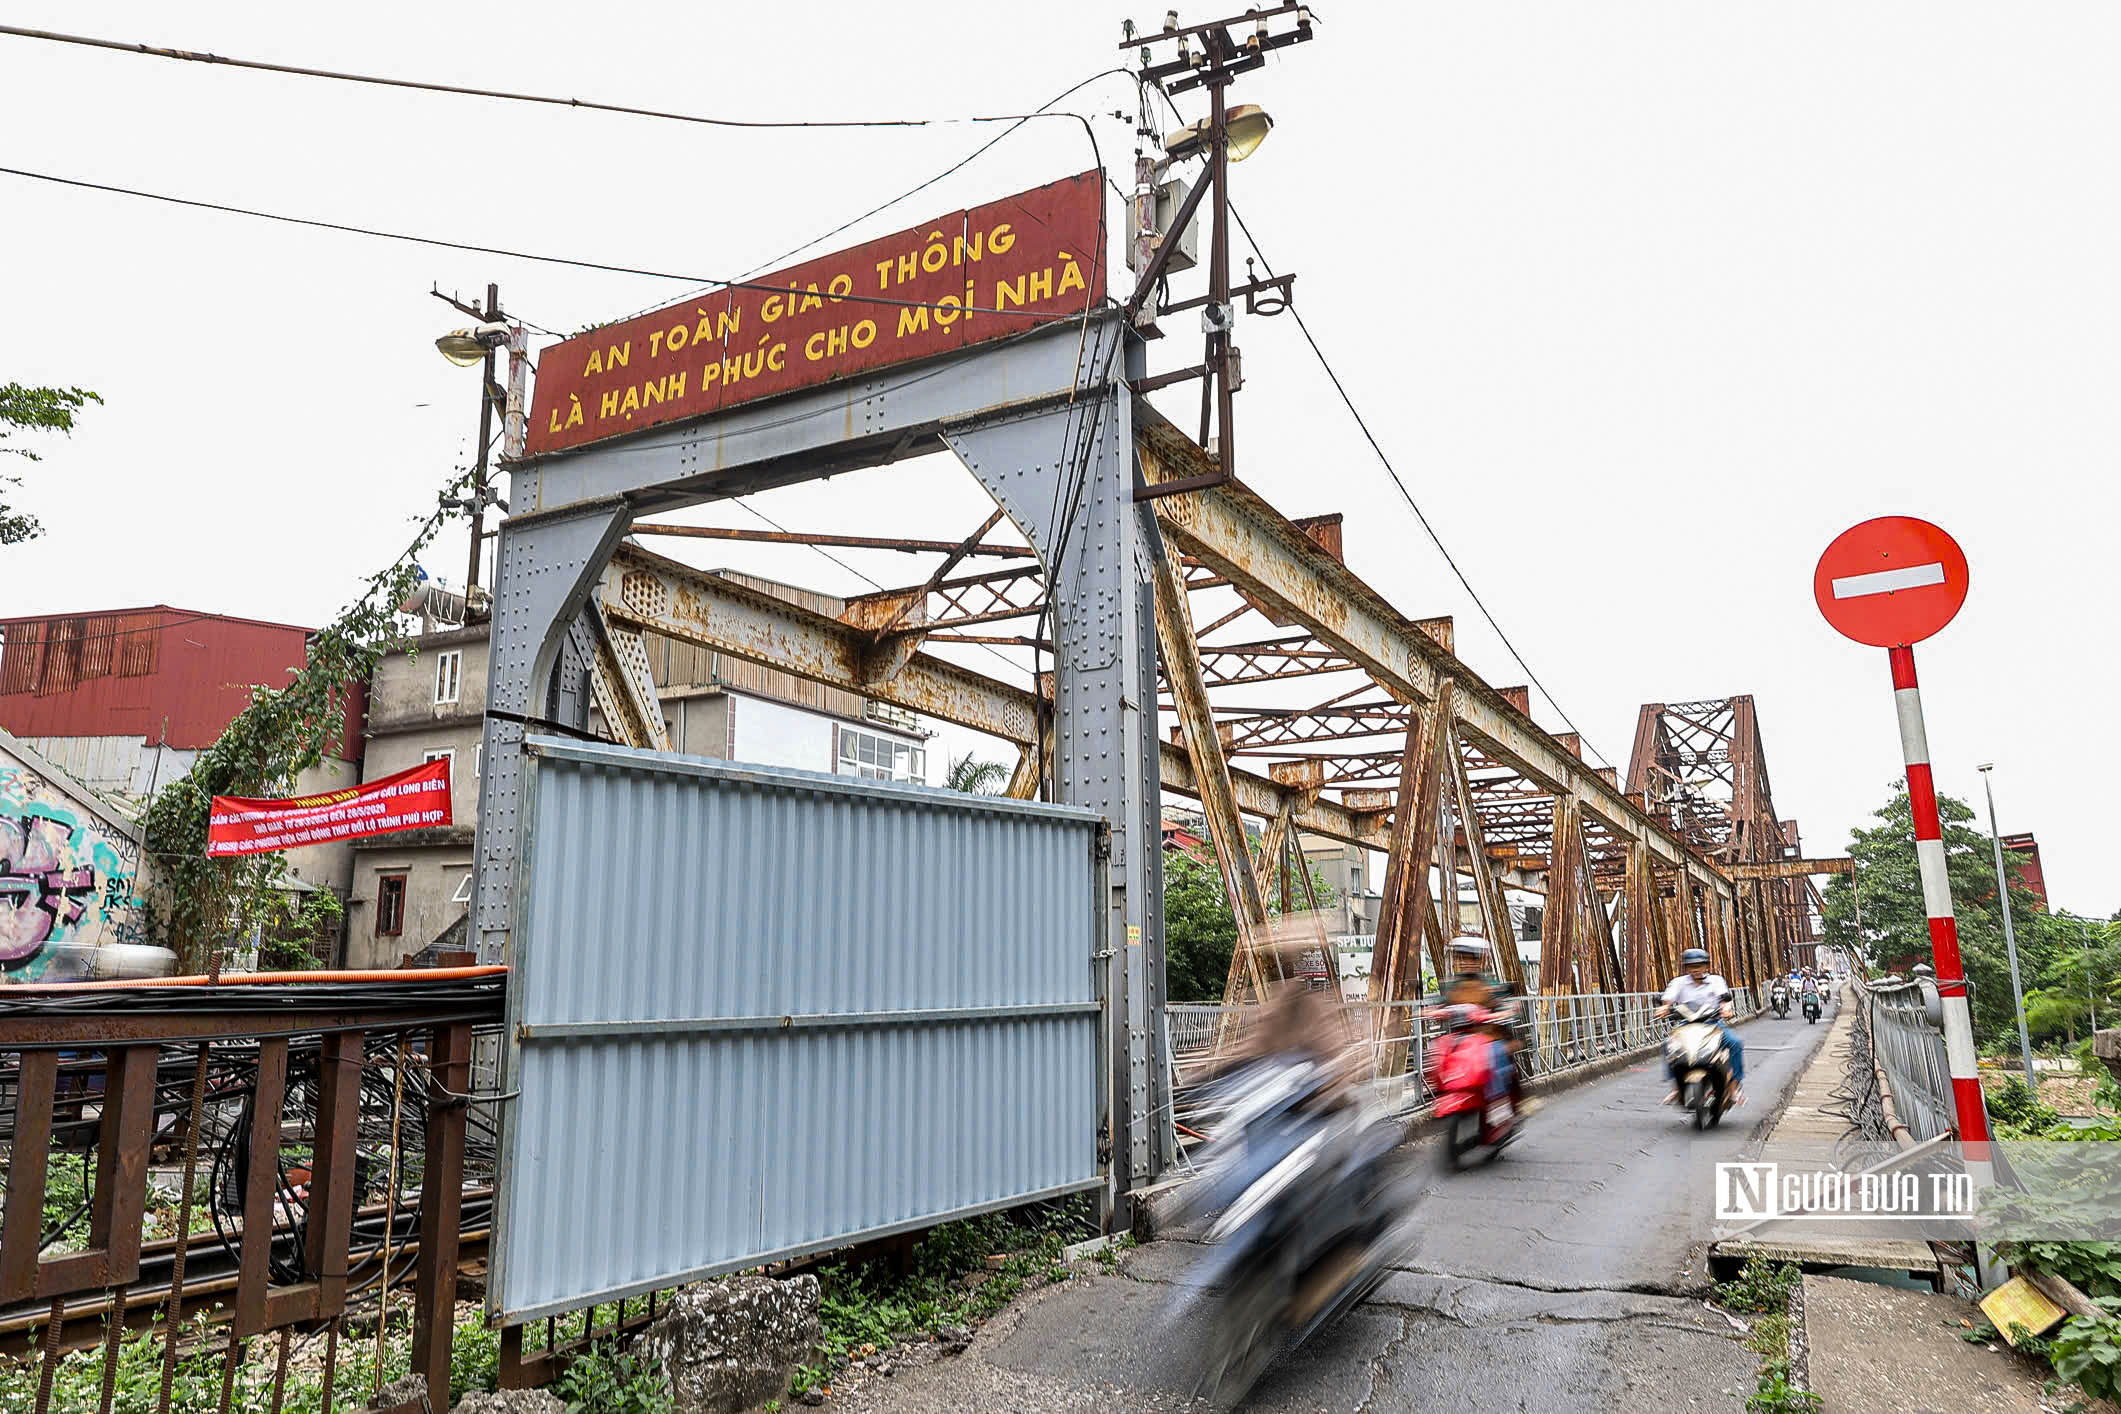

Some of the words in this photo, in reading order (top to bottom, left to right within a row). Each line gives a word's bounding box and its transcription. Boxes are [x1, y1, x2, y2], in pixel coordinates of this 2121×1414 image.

[583, 341, 631, 377] AN
[649, 306, 741, 358] TOÀN
[760, 274, 852, 323] GIAO
[876, 223, 1016, 289] THÔNG
[549, 392, 584, 433] LÀ
[600, 371, 687, 420] HẠNH
[702, 333, 787, 392] PHÚC
[805, 319, 877, 361] CHO
[896, 280, 974, 338] MỌI
[996, 251, 1086, 312] NHÀ
[398, 782, 421, 796] LONG
[422, 778, 446, 791] BIÊN
[377, 814, 402, 829] TRÌNH
[402, 811, 420, 825] PHÙ
[422, 810, 444, 823] HỢP
[1337, 935, 1357, 948] SPA
